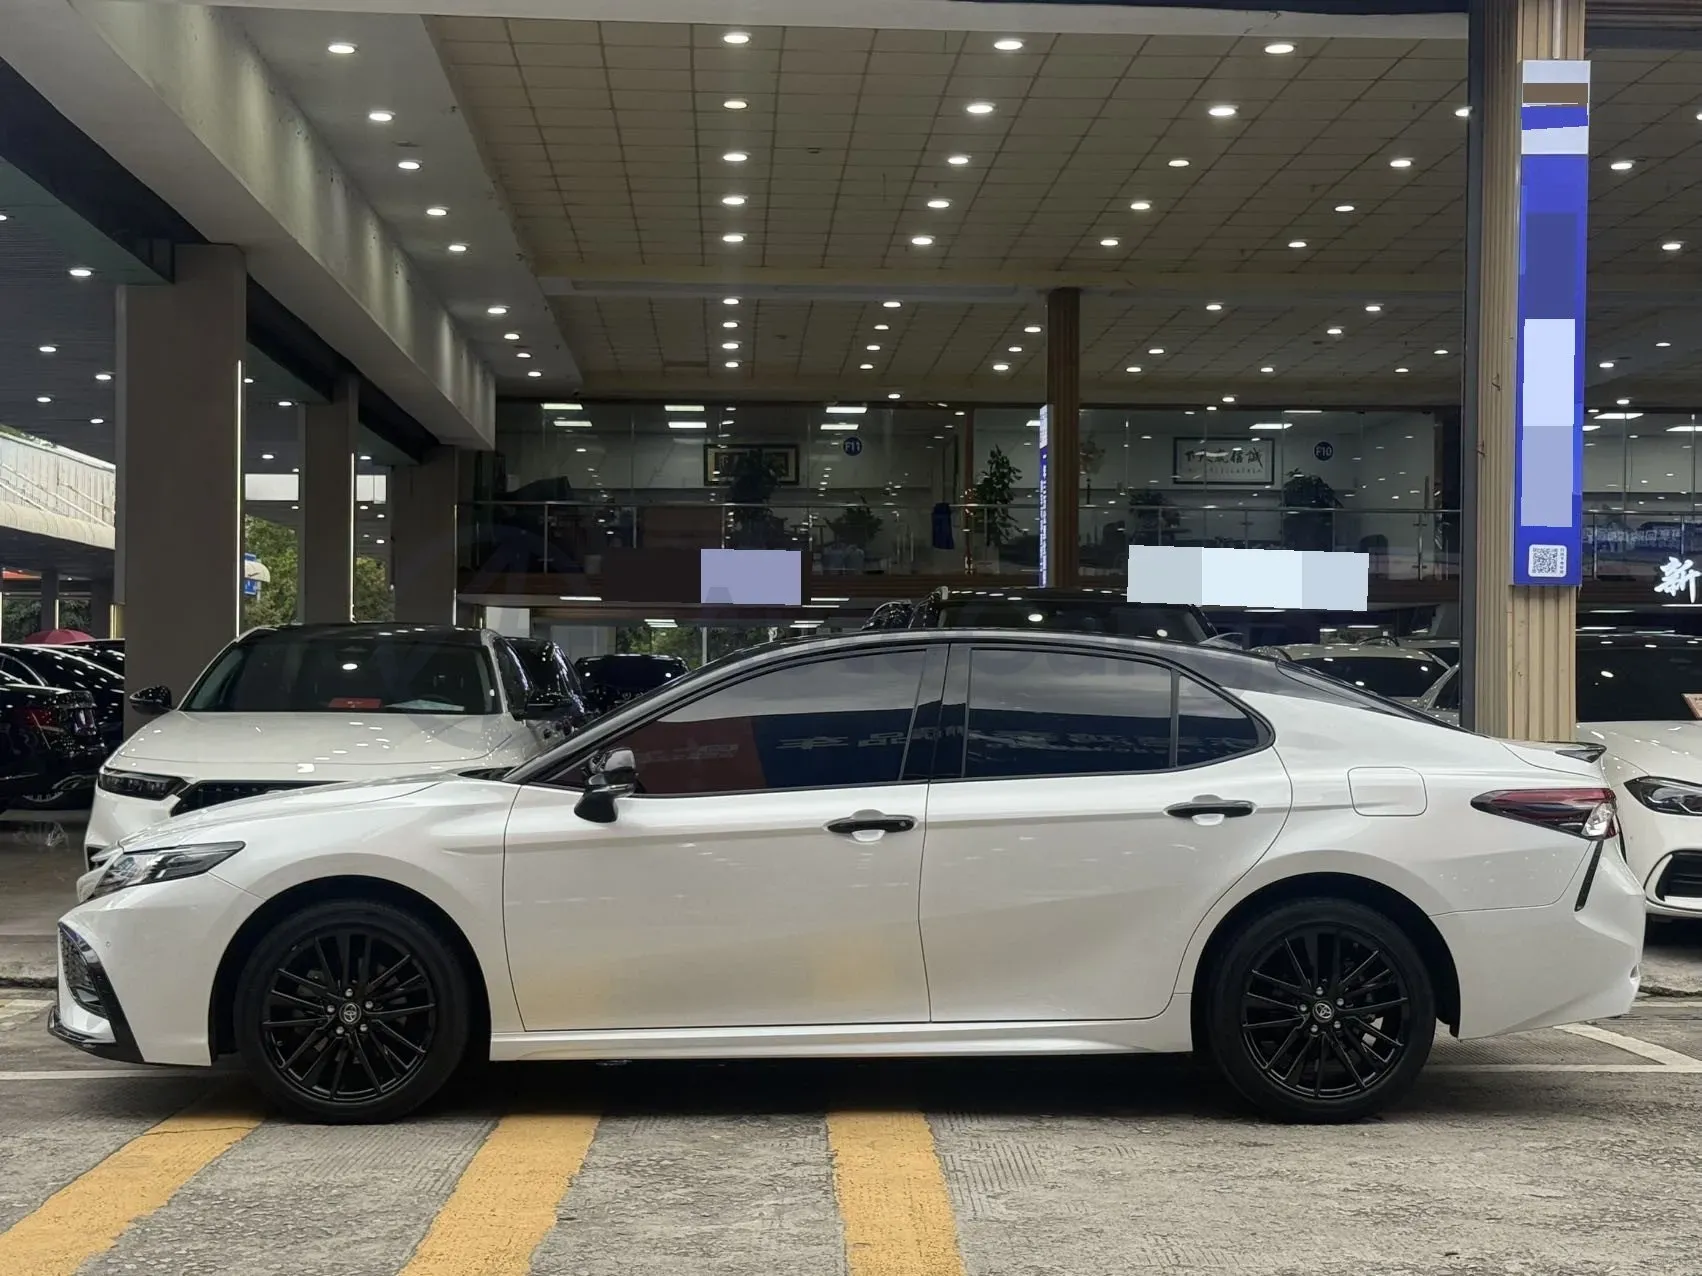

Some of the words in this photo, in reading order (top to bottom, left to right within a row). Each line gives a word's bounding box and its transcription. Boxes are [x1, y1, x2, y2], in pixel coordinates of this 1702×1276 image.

[845, 441, 861, 453] F11
[1315, 446, 1332, 457] F10
[1653, 556, 1702, 604] 新
